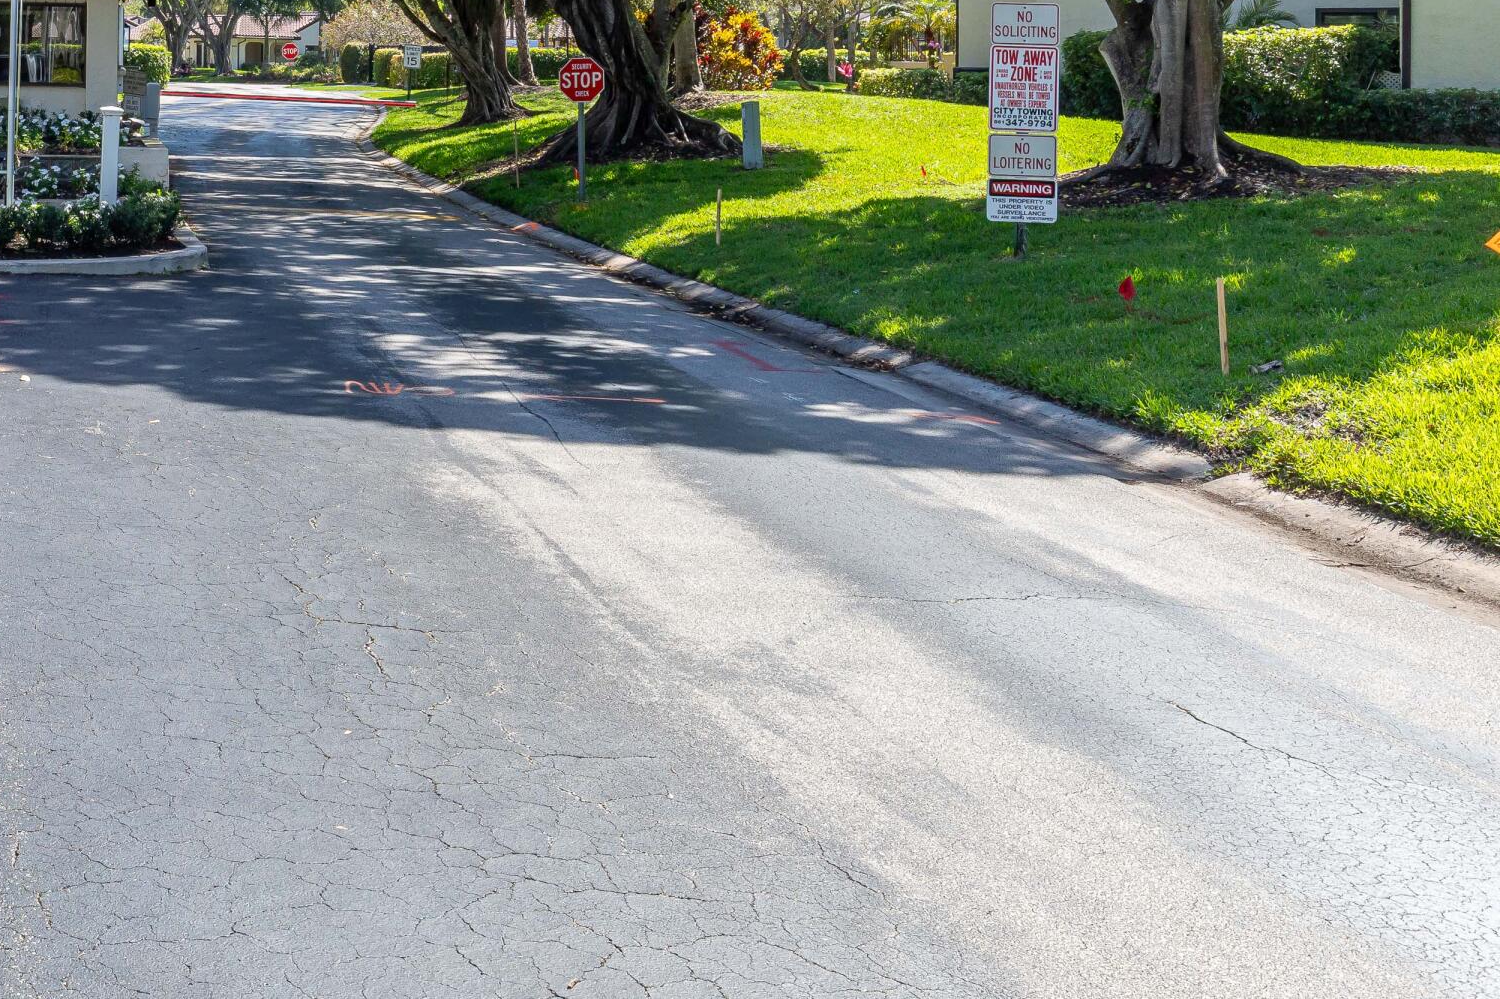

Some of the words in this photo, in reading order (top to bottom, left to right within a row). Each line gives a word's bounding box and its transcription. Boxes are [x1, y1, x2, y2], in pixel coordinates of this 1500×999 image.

[1017, 10, 1033, 22] NO
[994, 24, 1056, 38] SOLICITING
[407, 56, 418, 66] 15
[995, 49, 1019, 64] TOW
[1023, 50, 1054, 66] AWAY
[562, 72, 602, 88] STOP
[1010, 66, 1038, 82] ZONE
[995, 82, 1026, 90] UNAUTHORIZED
[1005, 119, 1052, 127] 347-9794
[1014, 142, 1030, 154] NO
[993, 157, 1052, 170] LOITERING
[992, 184, 1052, 194] WARNING
